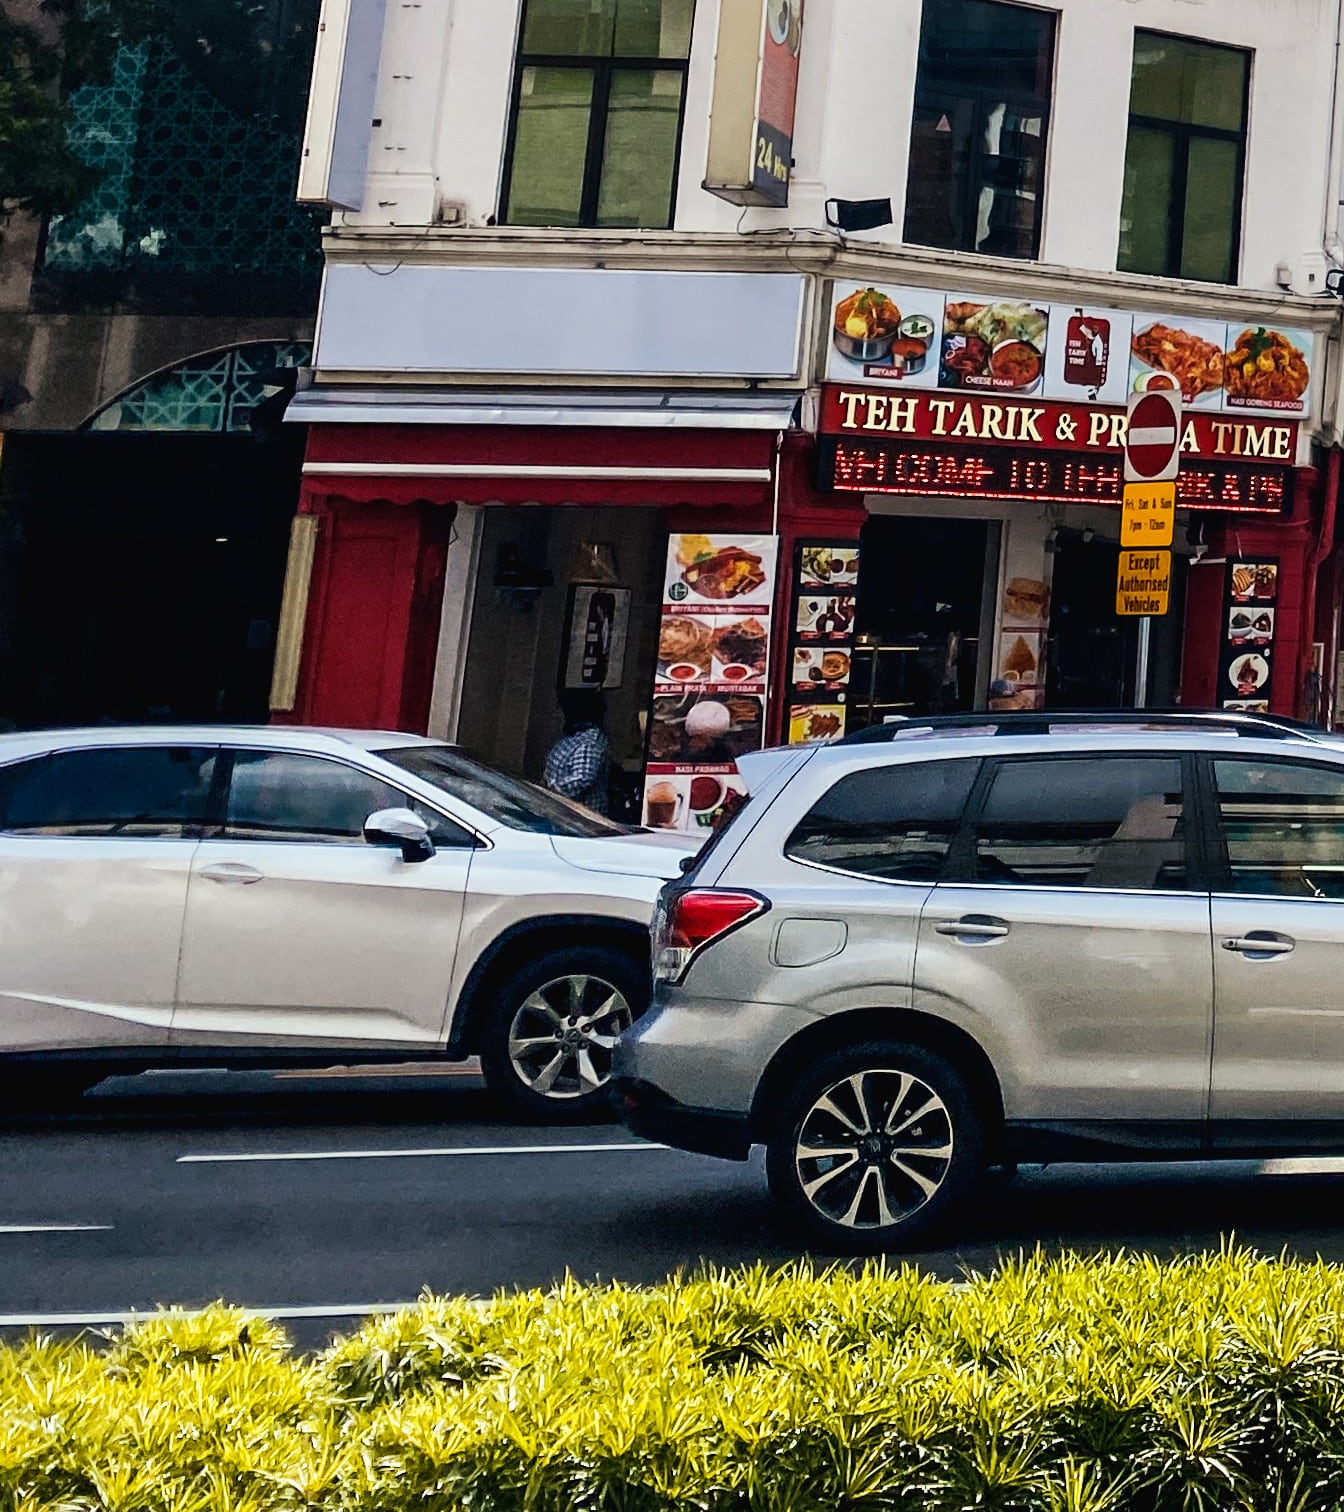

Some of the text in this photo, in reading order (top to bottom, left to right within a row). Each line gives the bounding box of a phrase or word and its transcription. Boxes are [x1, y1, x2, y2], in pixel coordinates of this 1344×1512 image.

[757, 137, 773, 173] 24
[965, 375, 992, 386] CHEESE
[839, 391, 1292, 459] TEH TARIK & PRA TIME
[1128, 553, 1161, 577] Except
[1118, 574, 1168, 593] Authorised
[1123, 594, 1161, 613] Vehicles
